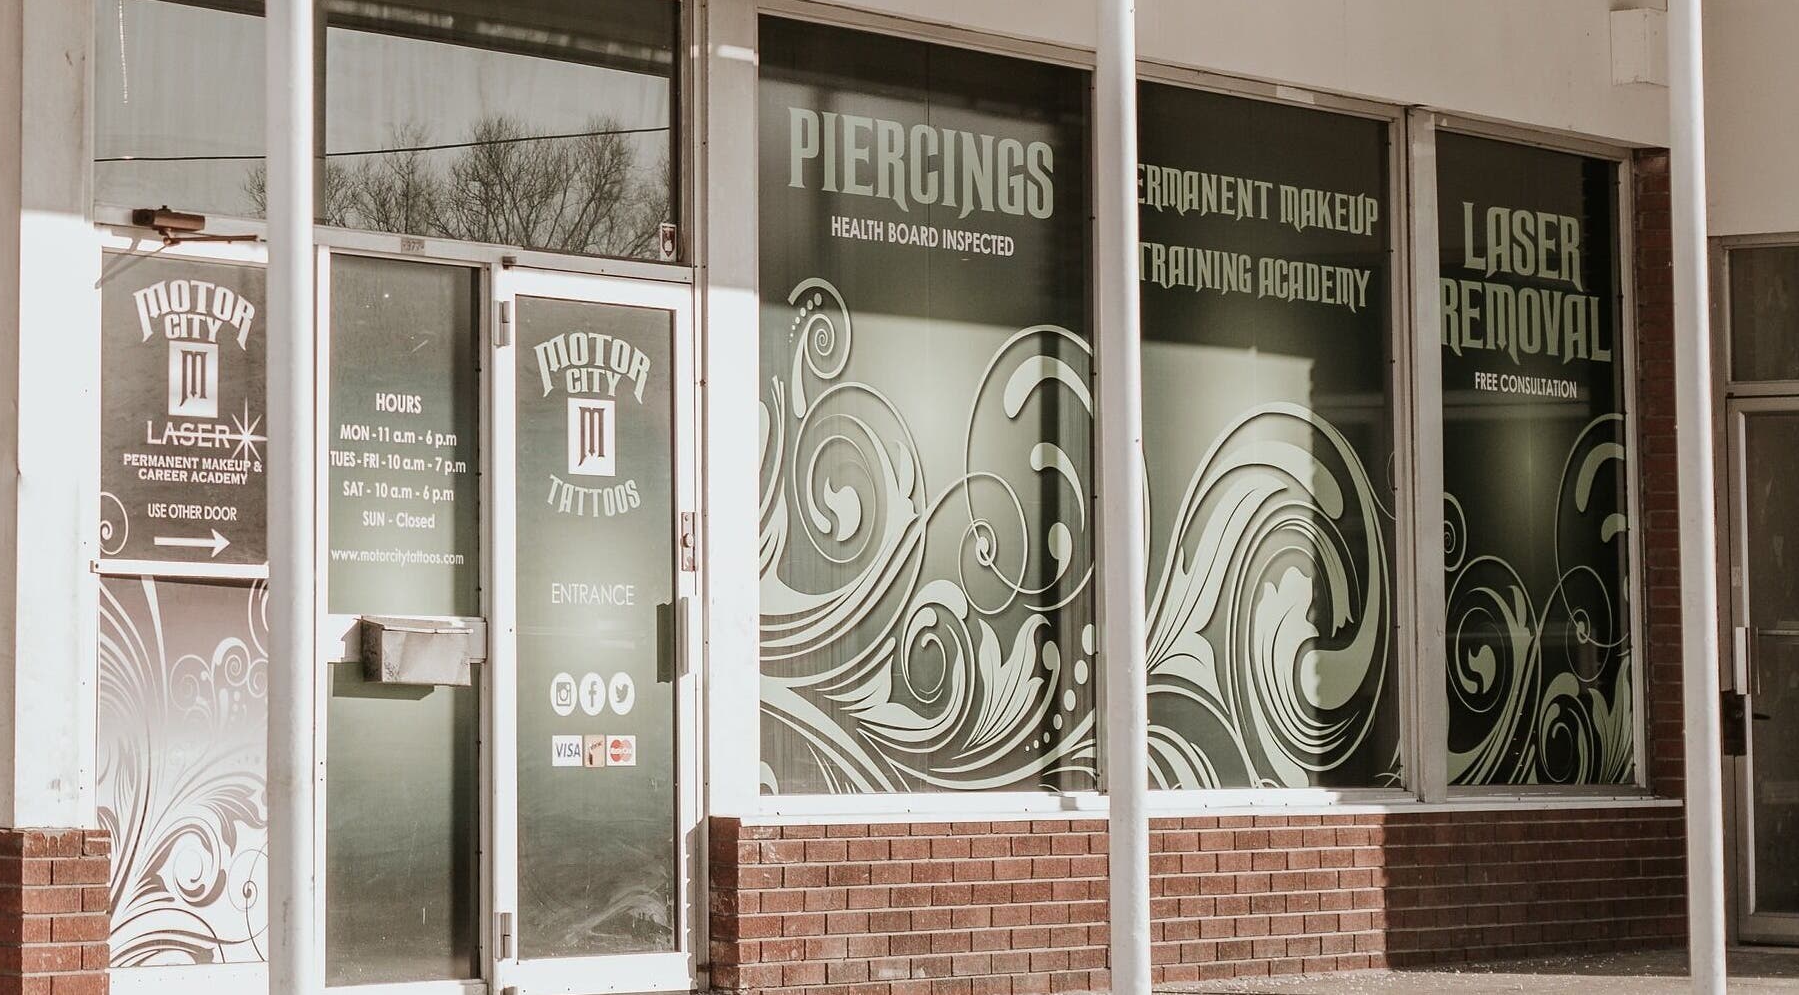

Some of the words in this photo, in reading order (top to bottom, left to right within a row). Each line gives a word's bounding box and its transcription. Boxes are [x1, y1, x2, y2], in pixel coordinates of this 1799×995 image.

[788, 107, 1053, 219] PIERCINGS
[1137, 163, 1273, 221] ERMANENT
[1279, 192, 1378, 236] MAKEUP
[831, 215, 884, 242] HEALTH
[888, 222, 938, 248] BOARD
[943, 228, 1014, 256] INSPECTED
[1462, 202, 1583, 292] LASER
[1138, 241, 1251, 296] TRAINING
[1258, 257, 1371, 313] ACADEMY
[132, 279, 255, 351] MOTOR
[164, 313, 223, 342] CITY
[1439, 277, 1612, 365] REMOVAL
[533, 332, 651, 405] MOTOR
[565, 368, 623, 397] CITY
[1475, 372, 1498, 391] FREE
[1500, 374, 1577, 398] CONSULTATION
[375, 393, 422, 414] HOURS
[146, 421, 230, 448] LASER
[340, 424, 370, 441] MON
[394, 431, 415, 444] a.m
[435, 433, 457, 448] p.m
[123, 453, 199, 469] PERMANENT
[202, 458, 251, 472] MAKEUP
[253, 461, 262, 473] &
[403, 458, 424, 471] a.m
[444, 460, 466, 475] p.m
[139, 468, 187, 482] CAREER
[191, 472, 248, 485] ACADEMY
[343, 481, 364, 496] SAT
[375, 482, 388, 497] 10
[391, 486, 412, 499] a.m
[432, 488, 454, 504] p.m
[547, 474, 641, 517] TATTOOS
[148, 503, 167, 518] USE
[168, 504, 202, 519] OTHER
[204, 506, 237, 521] DOOR
[363, 510, 385, 526] SUN
[396, 512, 435, 528] Closed
[331, 548, 464, 567] www.motorcitytattoos.com
[551, 582, 635, 605] ENTRANCE
[556, 743, 581, 758] VISA
